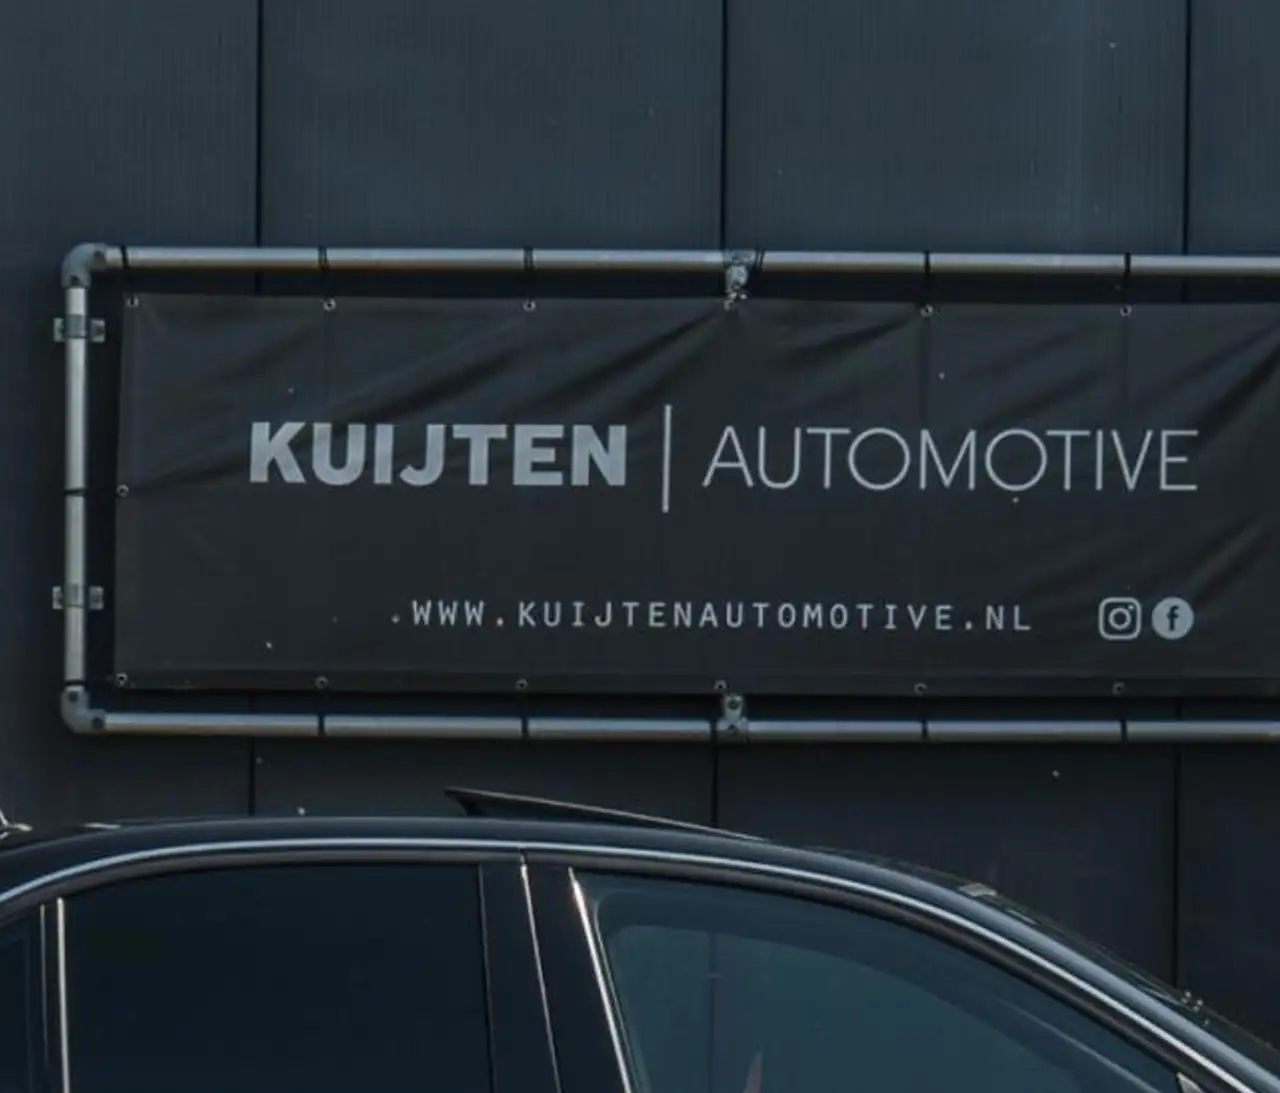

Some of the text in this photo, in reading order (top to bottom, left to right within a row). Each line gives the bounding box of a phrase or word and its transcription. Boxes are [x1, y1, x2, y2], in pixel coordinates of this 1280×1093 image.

[249, 421, 1198, 491] KUIJTEN AUTOMOTIVE
[411, 599, 1031, 631] WWW.KUIJTENAUTOMOTIVE.NL
